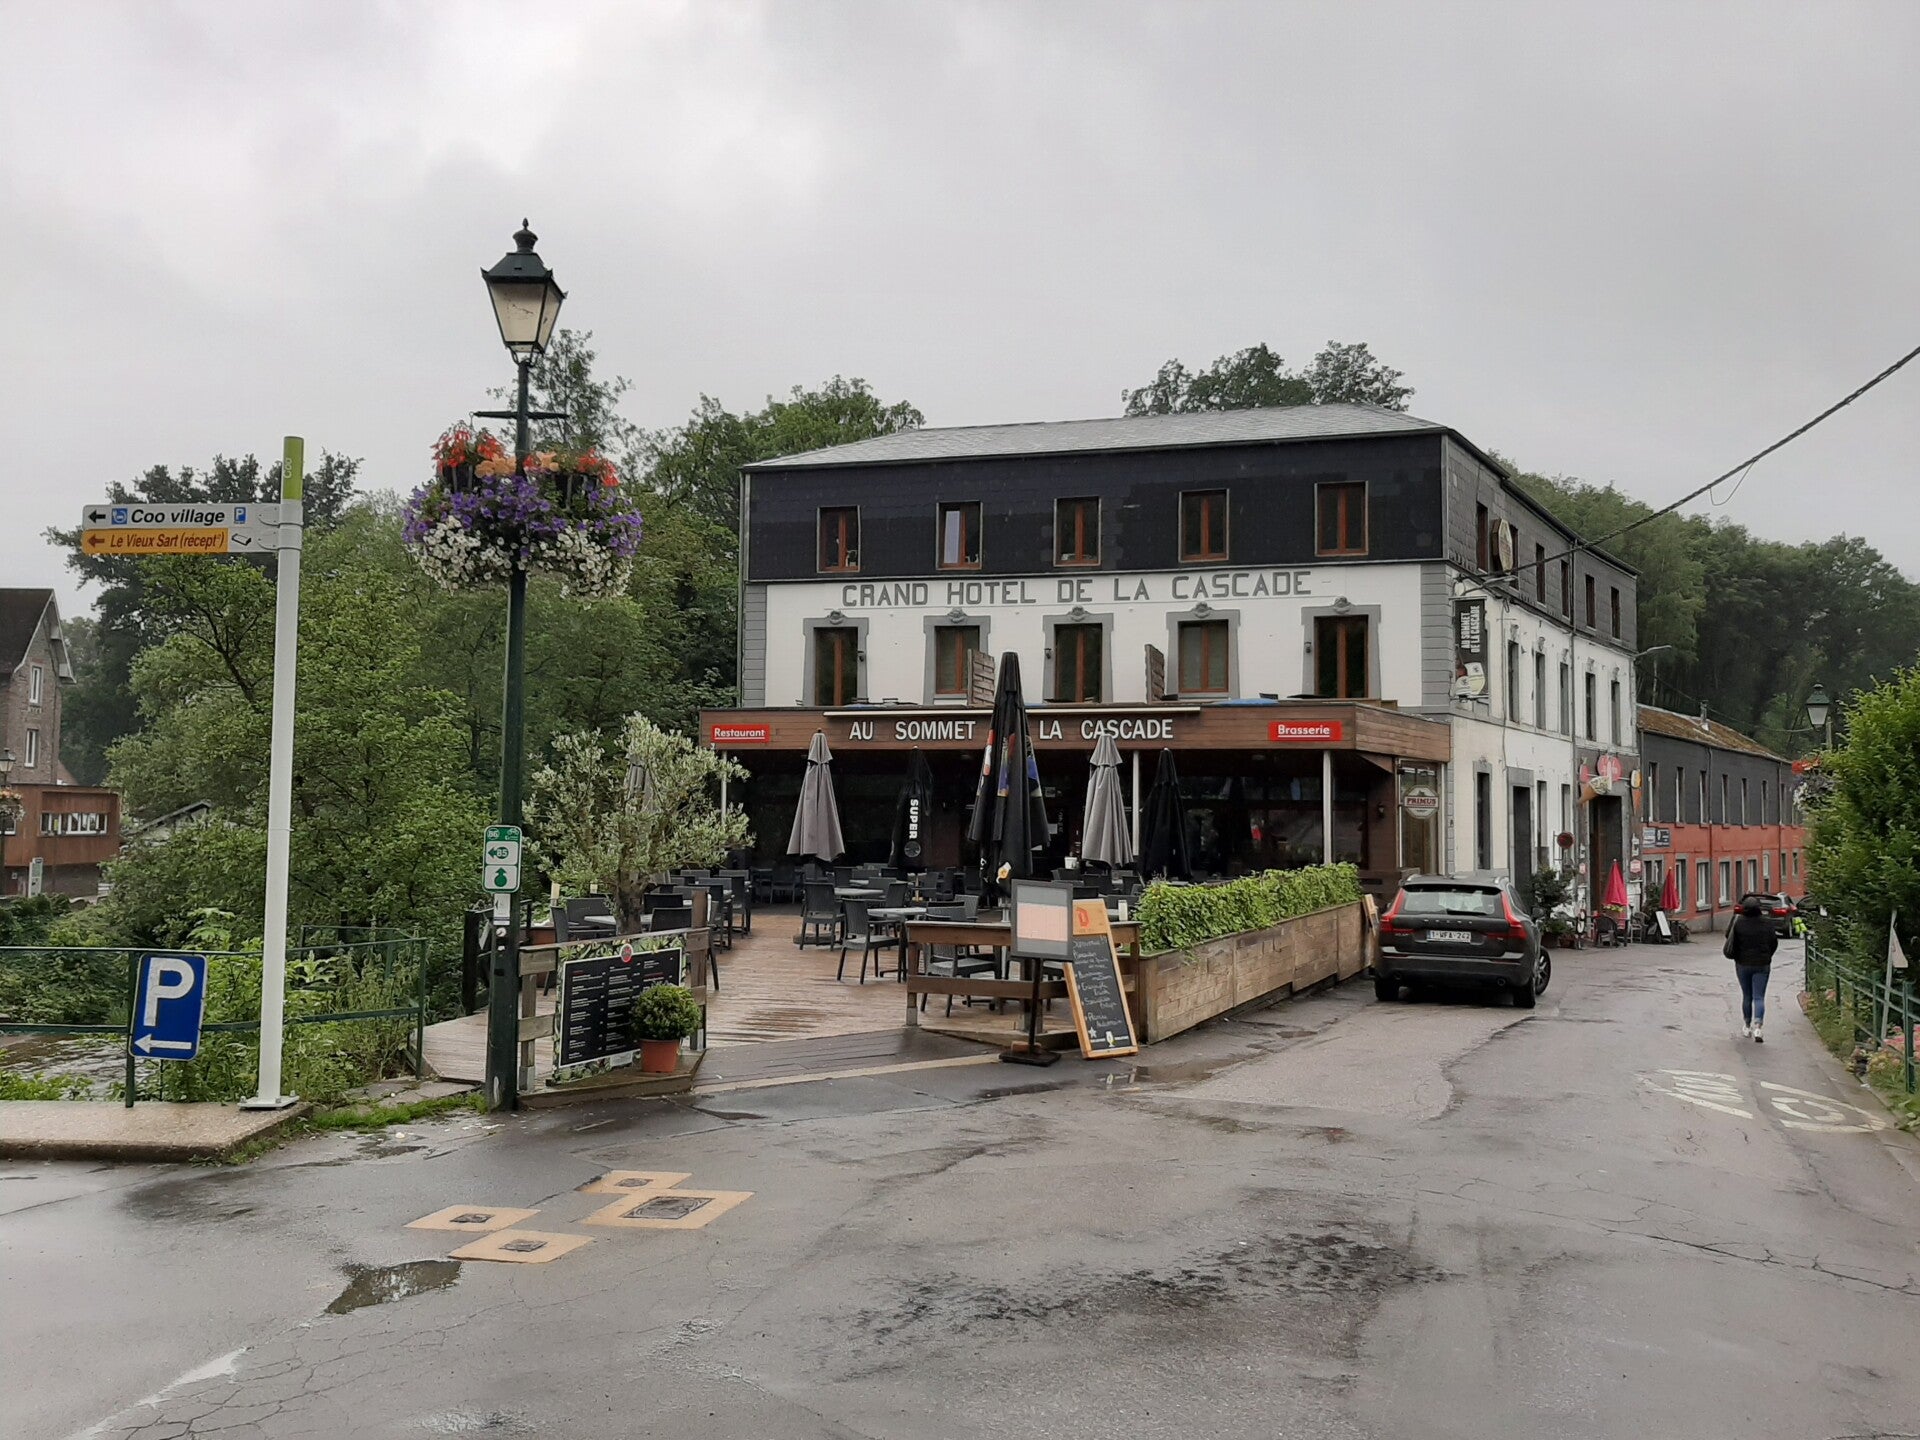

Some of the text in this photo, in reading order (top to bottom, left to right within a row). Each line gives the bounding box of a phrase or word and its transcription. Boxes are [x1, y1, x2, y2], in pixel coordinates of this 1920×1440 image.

[284, 457, 293, 479] Coo
[131, 508, 225, 526] Coo village
[110, 534, 122, 548] Le
[127, 533, 154, 548] Vieux
[157, 533, 178, 548] Sart
[842, 571, 1311, 607] GRAND HOTEL DE LA CASCADE
[1461, 612, 1470, 649] AU SOMMET
[1470, 605, 1480, 653] DE LA CASCADE
[714, 727, 766, 738] Restaurant
[849, 719, 1173, 740] AU SOMMET LA CASCADE
[1278, 724, 1331, 735] Brasserie
[1406, 797, 1437, 806] PRIMUS
[909, 799, 919, 840] SUPER
[143, 957, 195, 1027] P
